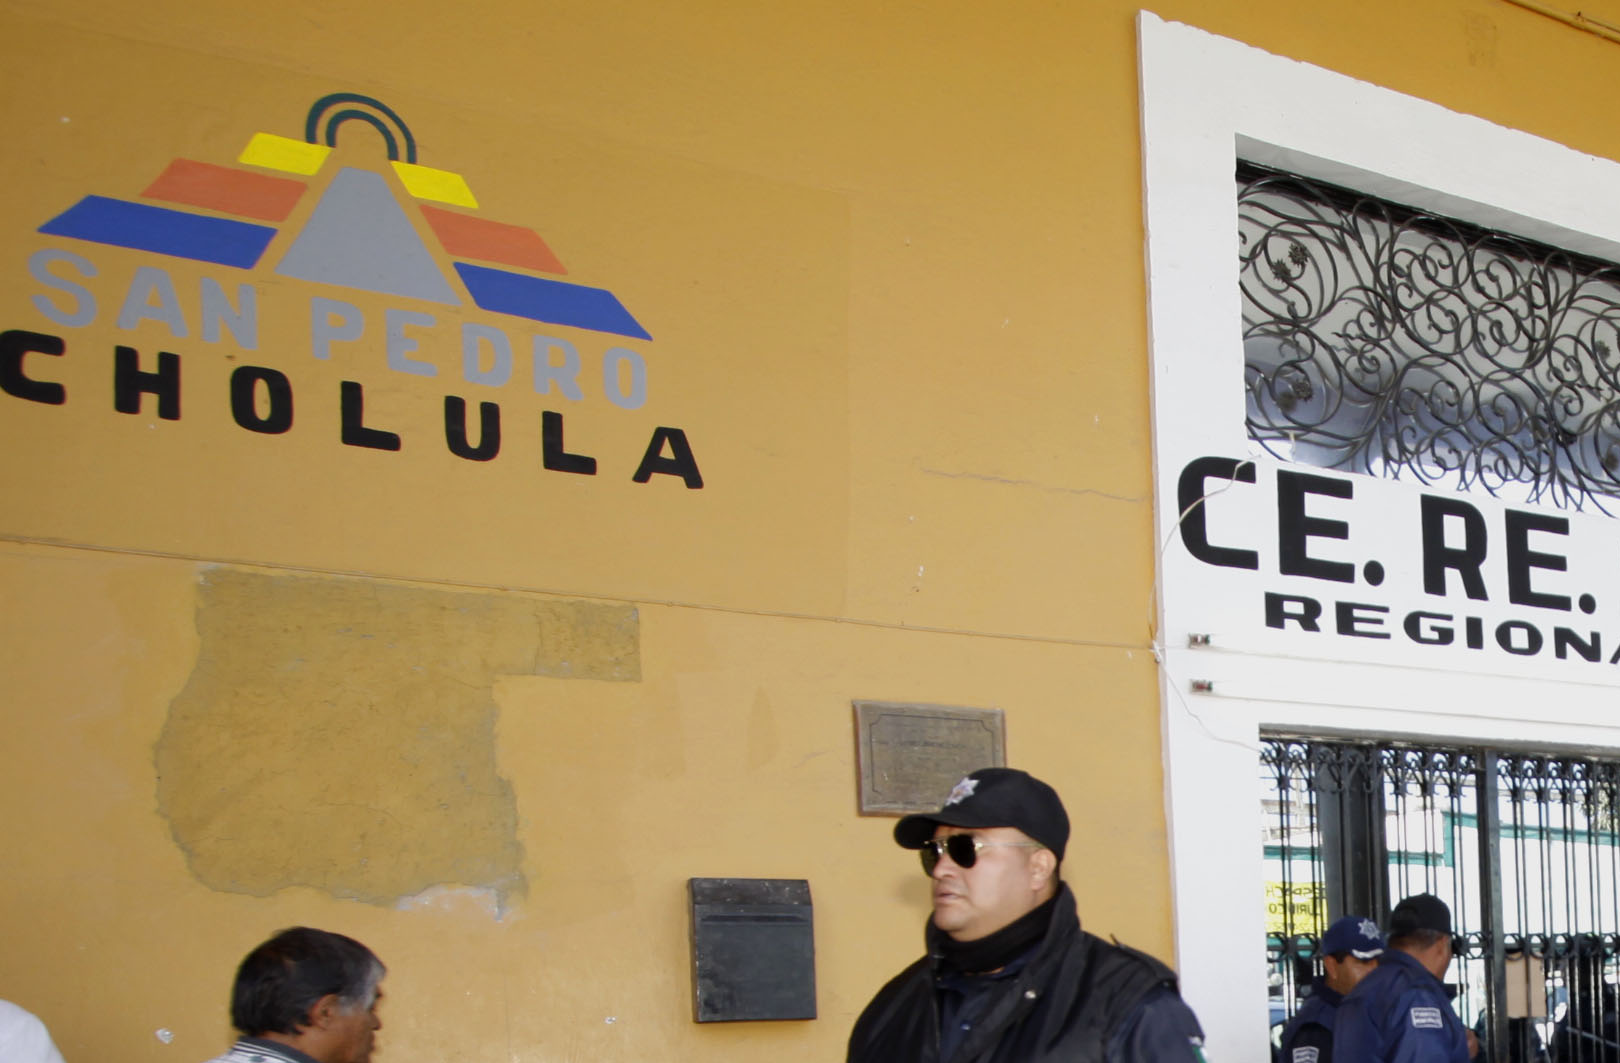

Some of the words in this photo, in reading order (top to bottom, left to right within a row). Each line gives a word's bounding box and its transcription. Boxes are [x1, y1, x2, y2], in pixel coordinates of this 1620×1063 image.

[0, 329, 704, 489] CHOLULA
[27, 248, 258, 351] SAN
[311, 296, 648, 411] PEDRO
[1177, 456, 1385, 587] CE.
[1420, 493, 1597, 614] RE.
